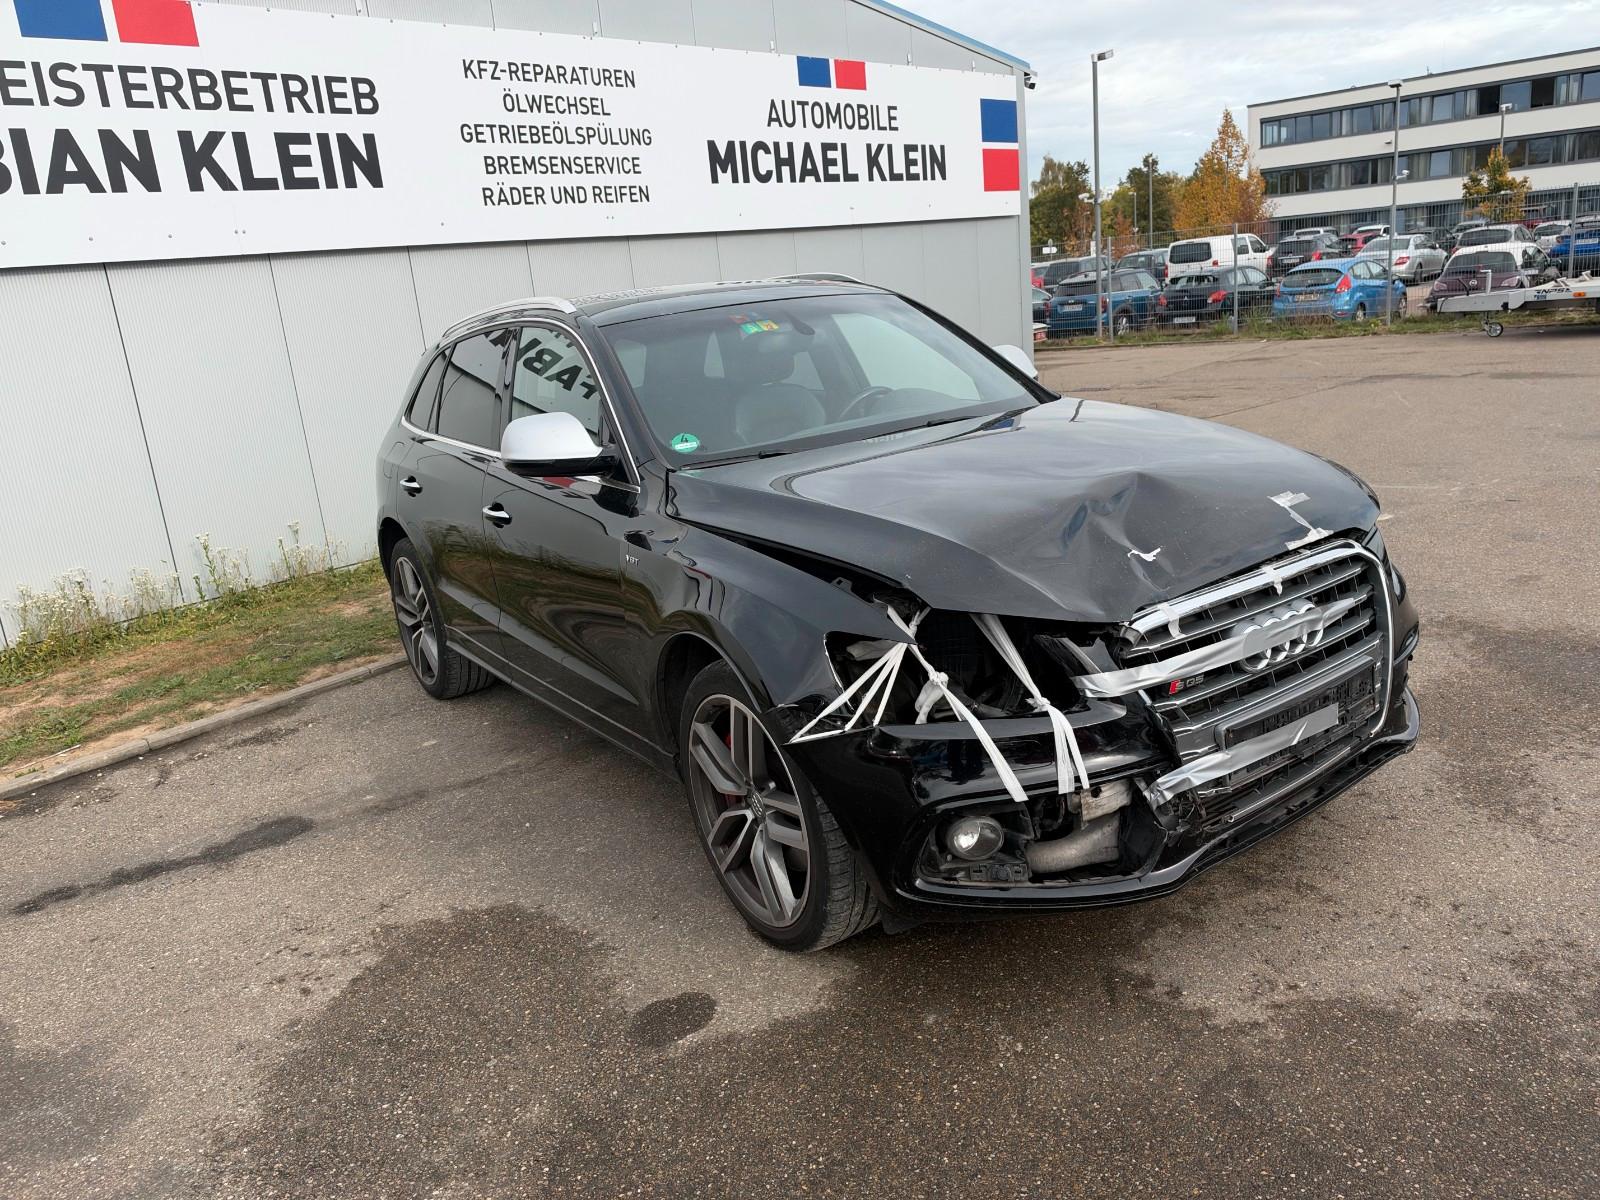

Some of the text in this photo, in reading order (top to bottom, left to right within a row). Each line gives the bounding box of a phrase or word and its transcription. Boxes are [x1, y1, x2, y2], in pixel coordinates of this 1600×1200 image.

[0, 60, 379, 115] EISTERBETRIEB
[462, 59, 636, 88] KFZ-REPARATUREN
[502, 88, 611, 116] ÖLWECHSEL
[767, 98, 899, 132] AUTOMOBILE
[460, 121, 652, 146] GETRIEBEÖLSPÜLUNG
[0, 128, 384, 195] IAN KLEIN
[483, 155, 642, 175] BREMSENSERVICE
[707, 139, 947, 184] MICHAEL KLEIN
[482, 182, 650, 206] RÄDER UND REIFEN
